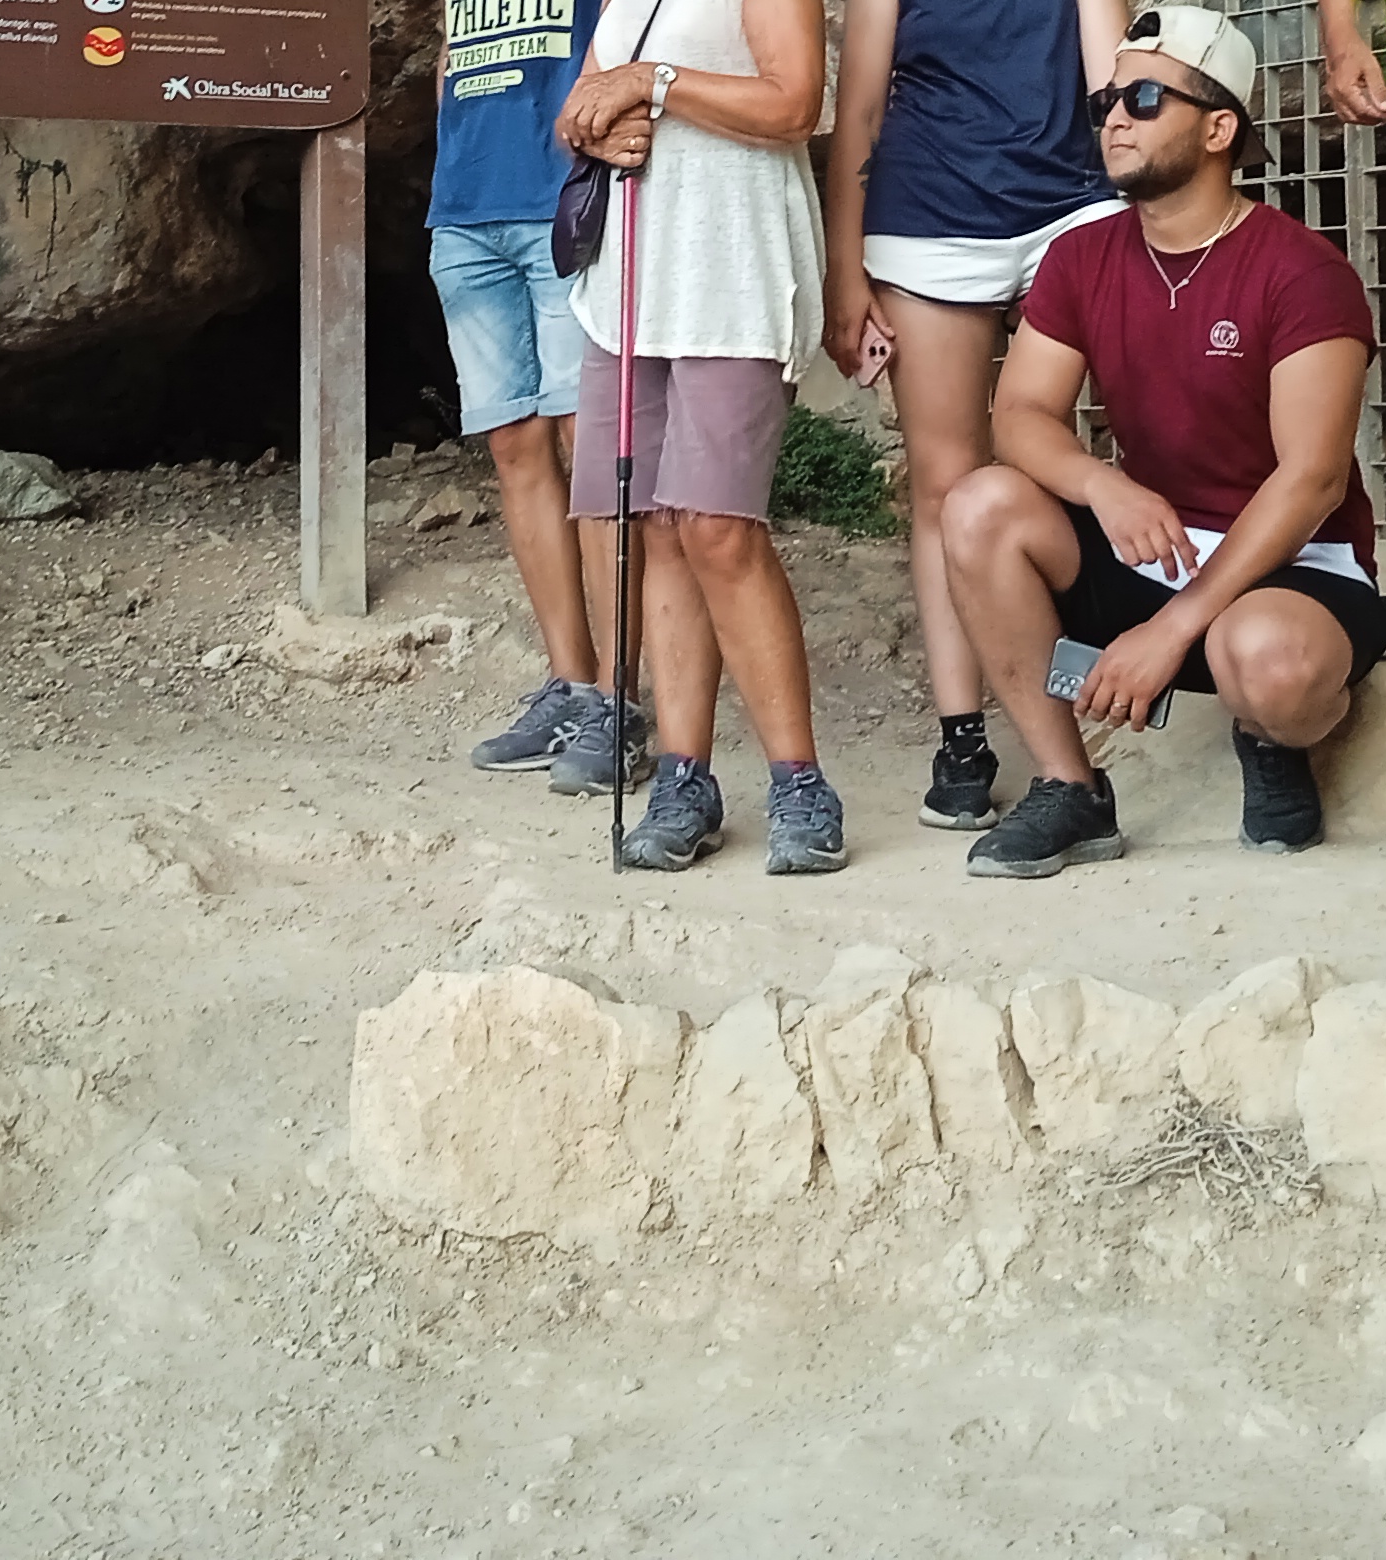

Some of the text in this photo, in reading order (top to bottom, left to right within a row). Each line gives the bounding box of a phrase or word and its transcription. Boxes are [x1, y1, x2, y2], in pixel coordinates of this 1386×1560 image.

[510, 36, 547, 58] TEAM
[194, 80, 331, 99] Obra Social "la Caixa"
